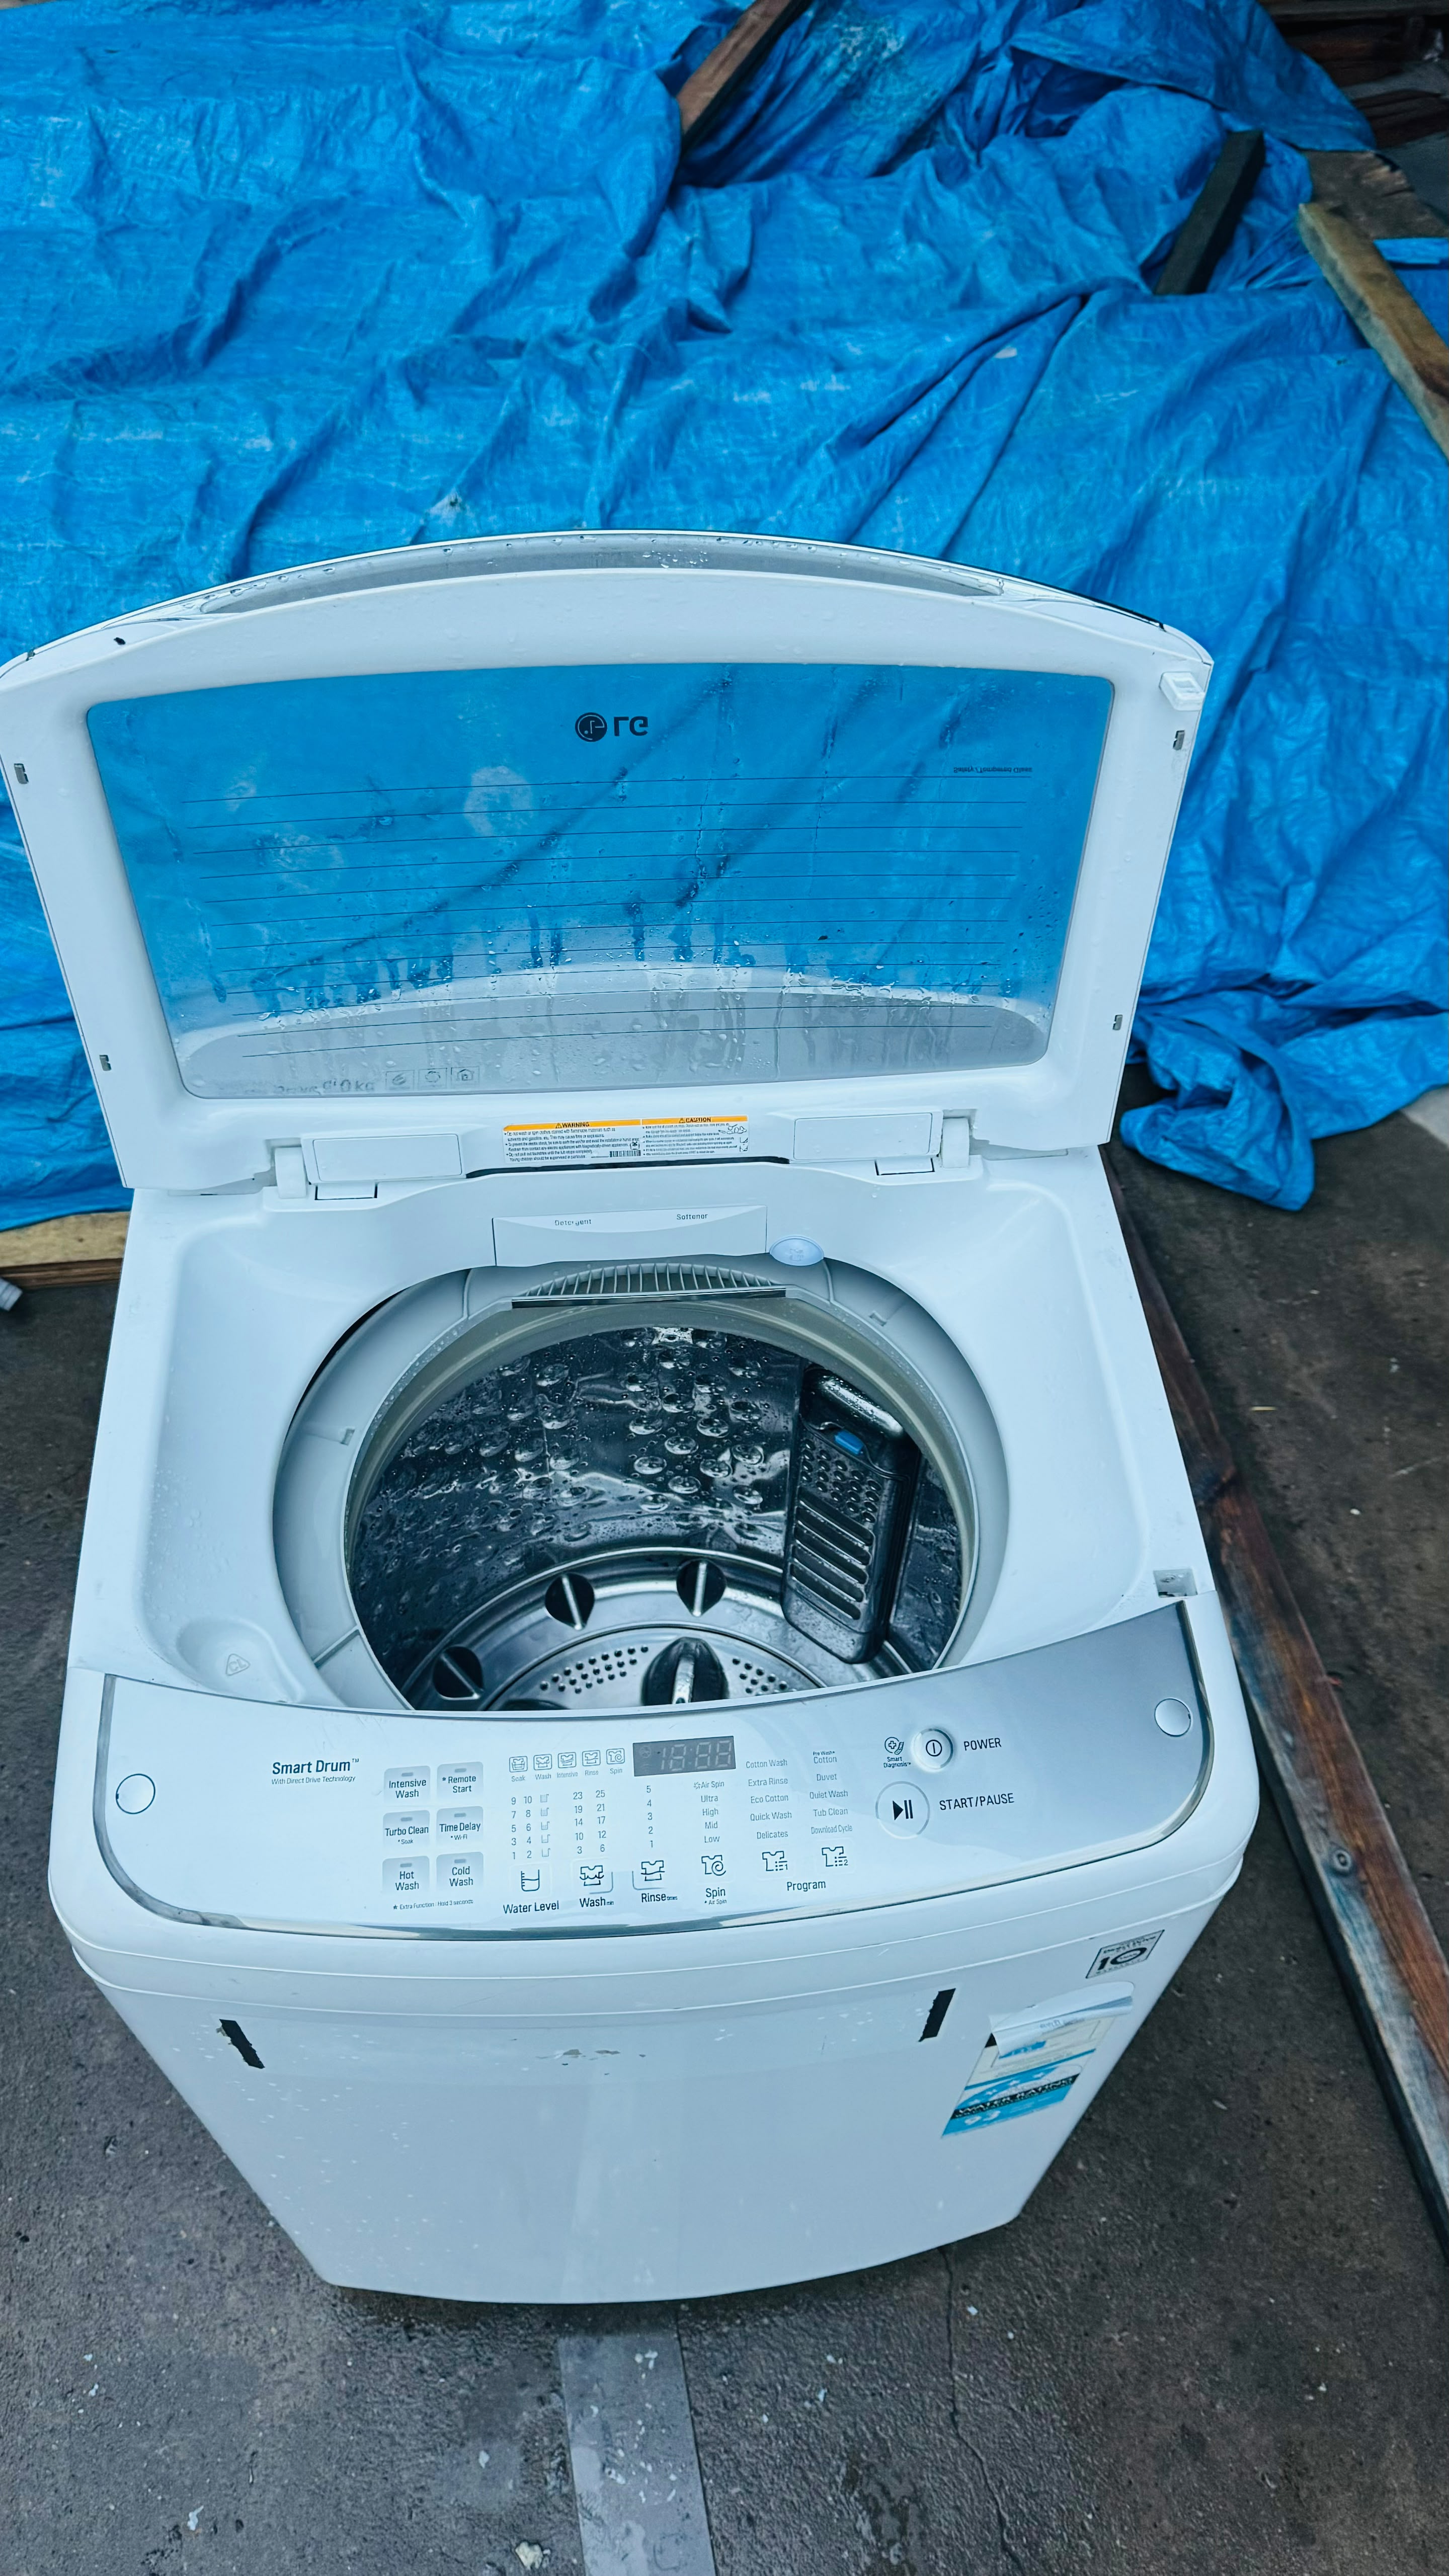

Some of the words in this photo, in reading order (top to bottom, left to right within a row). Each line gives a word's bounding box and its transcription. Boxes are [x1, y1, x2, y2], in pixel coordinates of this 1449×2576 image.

[963, 1737, 1002, 1751] POWER
[813, 1756, 837, 1764] Cotton
[272, 1761, 312, 1775] Smart
[389, 1779, 427, 1789] Intensive
[448, 1776, 476, 1784] Remote
[711, 1781, 725, 1789] Spin
[769, 1777, 788, 1785] Rinse
[395, 1789, 419, 1799] Wash
[452, 1785, 472, 1793] Start
[829, 1790, 848, 1798] Wash
[573, 1792, 583, 1800] 23
[595, 1790, 605, 1798] 25
[701, 1795, 718, 1803] Ultra
[511, 1797, 516, 1805] 9
[523, 1796, 532, 1804] 10
[939, 1793, 1015, 1811] START/PAUSE
[574, 1805, 583, 1813] 19
[596, 1804, 605, 1812] 21
[702, 1808, 718, 1817] High
[813, 1809, 827, 1817] Tub
[828, 1807, 848, 1816] Clean
[511, 1811, 516, 1819] 7
[526, 1810, 531, 1818] 8
[648, 1812, 653, 1820] 3
[750, 1812, 770, 1821] Quick
[771, 1811, 792, 1820] Wash
[575, 1818, 583, 1826] 14
[597, 1816, 606, 1824] 17
[705, 1821, 718, 1829] Mid
[384, 1827, 407, 1836] Turbo
[408, 1826, 429, 1835] Clean
[439, 1823, 458, 1832] Time
[459, 1822, 481, 1832] Delay
[511, 1824, 516, 1832] 5
[526, 1823, 531, 1831] 6
[648, 1826, 654, 1834] 2
[811, 1825, 837, 1834] Download
[838, 1824, 853, 1833] Cycle
[575, 1832, 584, 1840] 10
[598, 1830, 607, 1839] 12
[757, 1831, 788, 1839] Delicates
[511, 1838, 517, 1846] 3
[526, 1836, 531, 1844] 4
[650, 1840, 653, 1848] 1
[577, 1846, 582, 1854] 3
[600, 1844, 605, 1852] 6
[512, 1852, 516, 1860] 1
[527, 1850, 532, 1859] 2
[399, 1871, 415, 1880] Hot
[452, 1866, 470, 1876] Cold
[395, 1881, 419, 1891] Wash
[449, 1877, 473, 1887] Wash
[787, 1881, 826, 1892] Program
[641, 1893, 667, 1903] Rinse
[705, 1887, 726, 1899] Spin
[503, 1903, 532, 1914] Water
[534, 1900, 559, 1911] Level
[579, 1896, 606, 1908] Wash
[1098, 1947, 1147, 1970] 10
